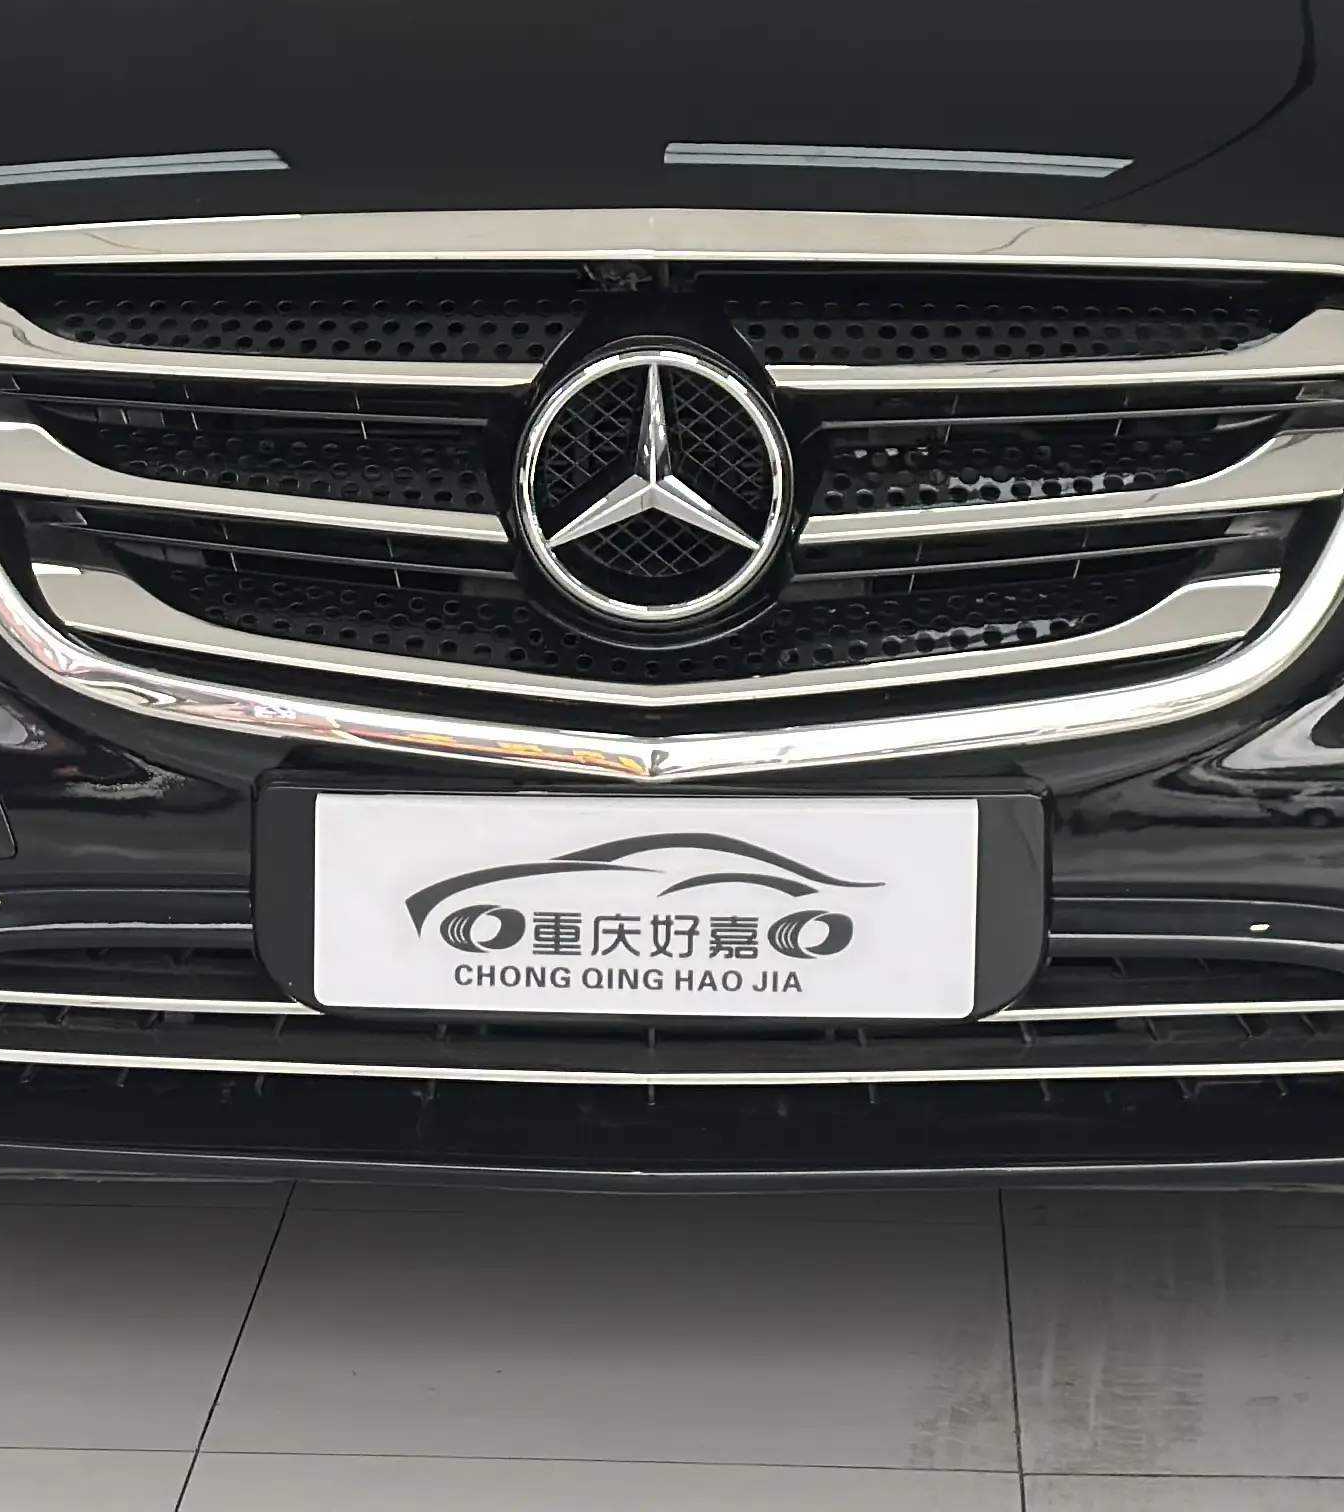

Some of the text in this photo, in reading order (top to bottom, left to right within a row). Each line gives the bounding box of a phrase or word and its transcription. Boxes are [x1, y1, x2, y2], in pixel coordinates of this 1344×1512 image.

[532, 910, 760, 961] 重庆好嘉
[453, 963, 803, 994] CHONG QING HAO JIA
